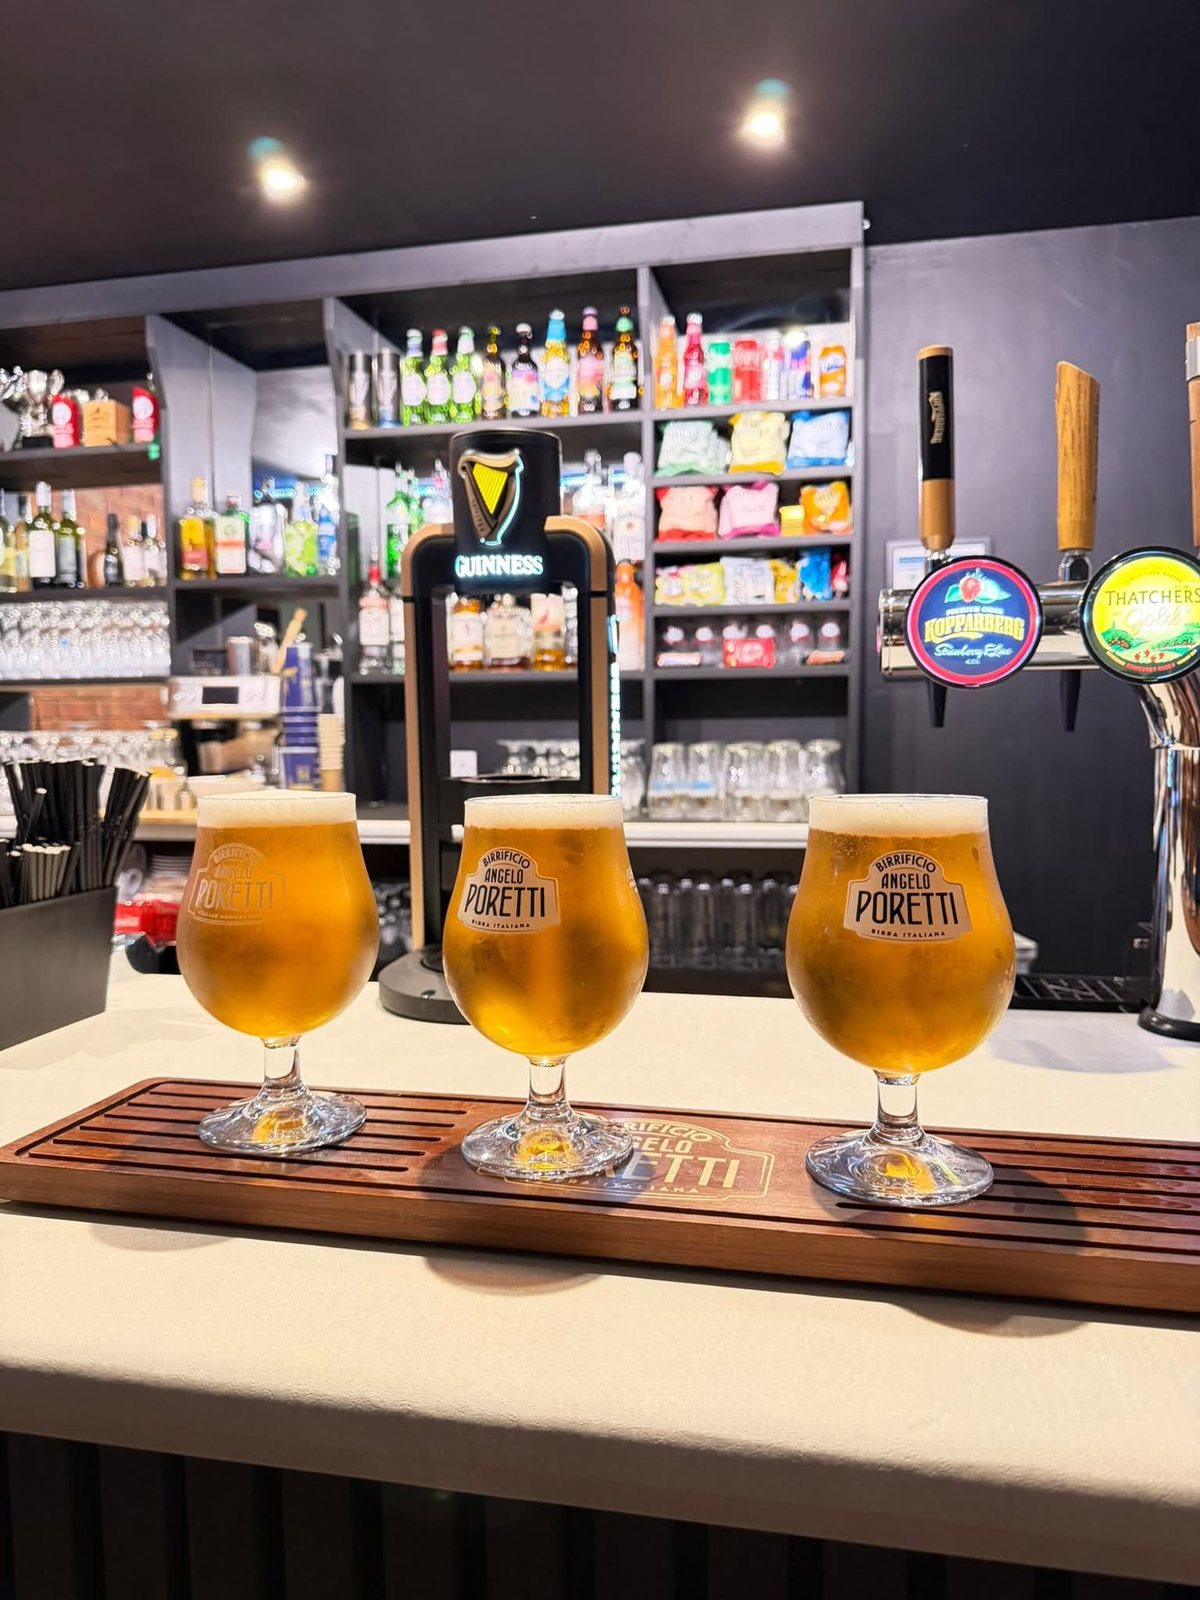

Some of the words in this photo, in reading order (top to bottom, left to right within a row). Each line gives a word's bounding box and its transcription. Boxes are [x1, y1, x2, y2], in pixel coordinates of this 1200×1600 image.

[455, 554, 544, 578] GUINNESS
[1105, 588, 1200, 606] THATCHERS
[924, 613, 1025, 643] KOPPARBERG
[482, 850, 531, 869] BIRRIFICIO
[875, 854, 937, 873] BIRRIFICIO
[484, 868, 524, 884] ANGELO
[881, 873, 930, 890] ANGELO
[195, 878, 273, 913] PORETTI
[464, 884, 545, 918] PORETTI
[856, 890, 959, 925] PORETTI
[871, 928, 898, 937] BIRRA
[902, 930, 946, 938] ITALIANA
[623, 1121, 713, 1142] RIFICIO
[606, 1151, 741, 1189] ETTI
